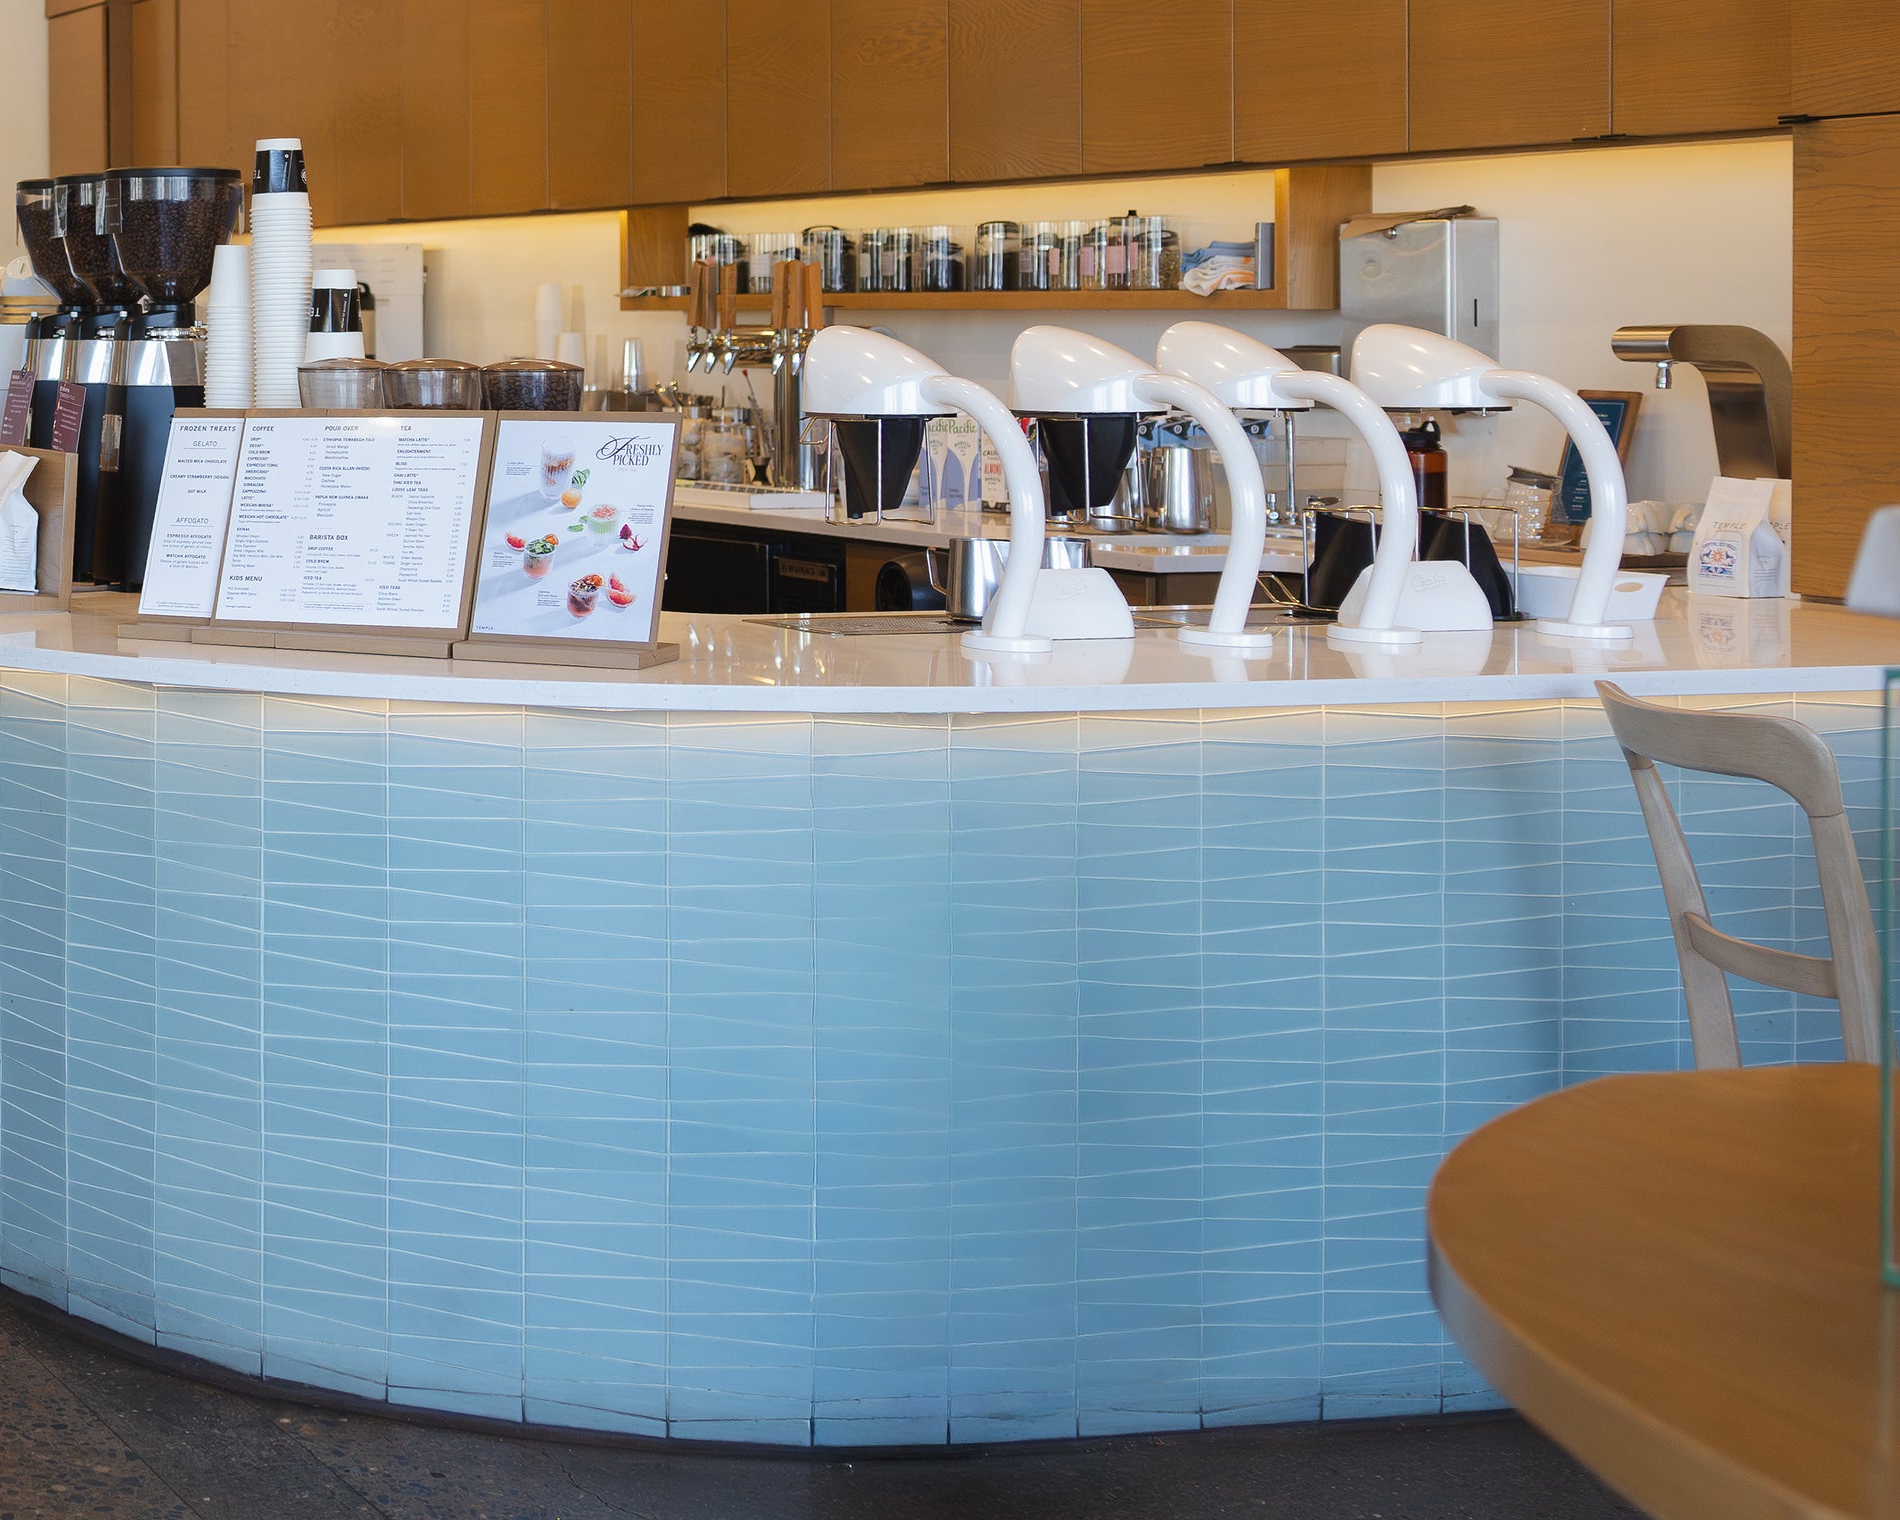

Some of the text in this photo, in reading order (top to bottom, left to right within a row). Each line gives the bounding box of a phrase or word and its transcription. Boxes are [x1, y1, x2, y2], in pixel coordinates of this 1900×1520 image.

[948, 419, 976, 434] Pacific
[596, 435, 663, 460] FRESHLY
[613, 454, 649, 466] PICKED
[1714, 521, 1747, 529] TEMPLE
